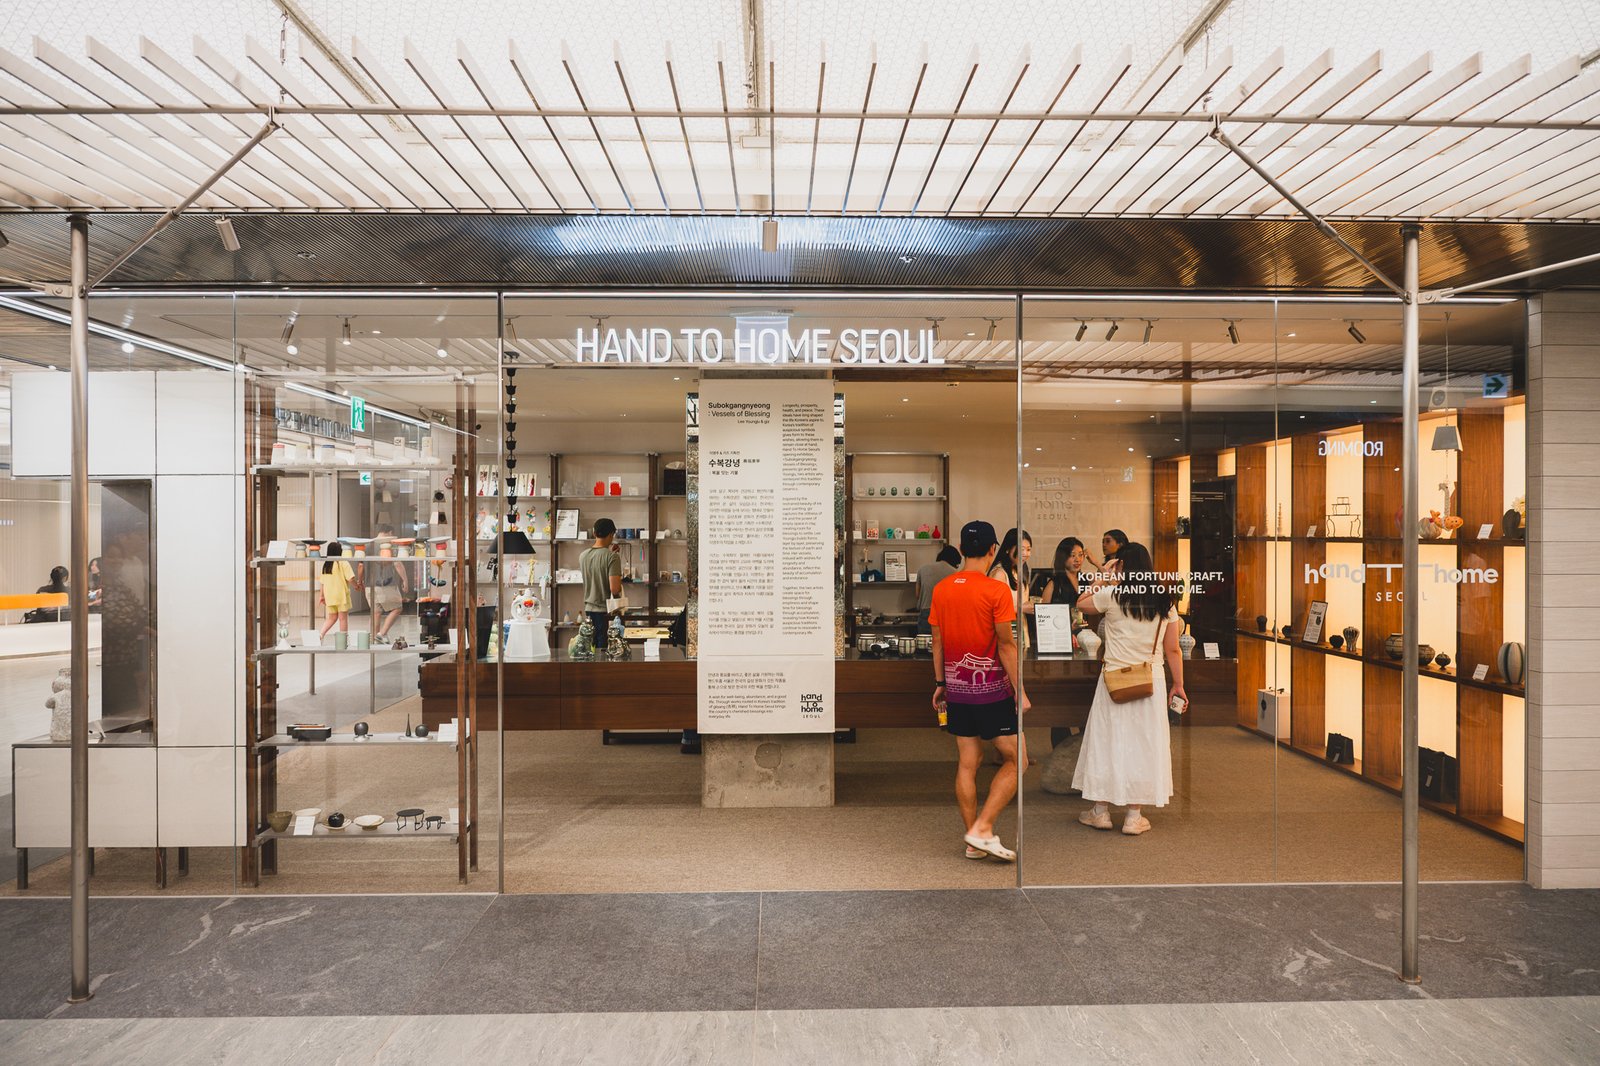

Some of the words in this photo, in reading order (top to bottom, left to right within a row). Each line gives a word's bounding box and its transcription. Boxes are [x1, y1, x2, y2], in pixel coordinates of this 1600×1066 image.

[576, 328, 671, 363] HAND
[680, 328, 724, 363] TO
[735, 328, 831, 364] HOME
[840, 328, 946, 364] SEOUL
[709, 458, 740, 467] 수복강녕
[1035, 477, 1070, 488] hand
[1035, 496, 1072, 510] home
[1078, 572, 1125, 581] KOREAN
[1129, 572, 1182, 581] FORTUNE
[1186, 572, 1224, 583] CRAFT,
[1304, 564, 1365, 584] hand
[1434, 564, 1499, 584] home
[1115, 585, 1147, 594] HAND
[1150, 585, 1162, 594] TO
[1169, 585, 1205, 594] HOME.
[1375, 592, 1428, 602] SEOL
